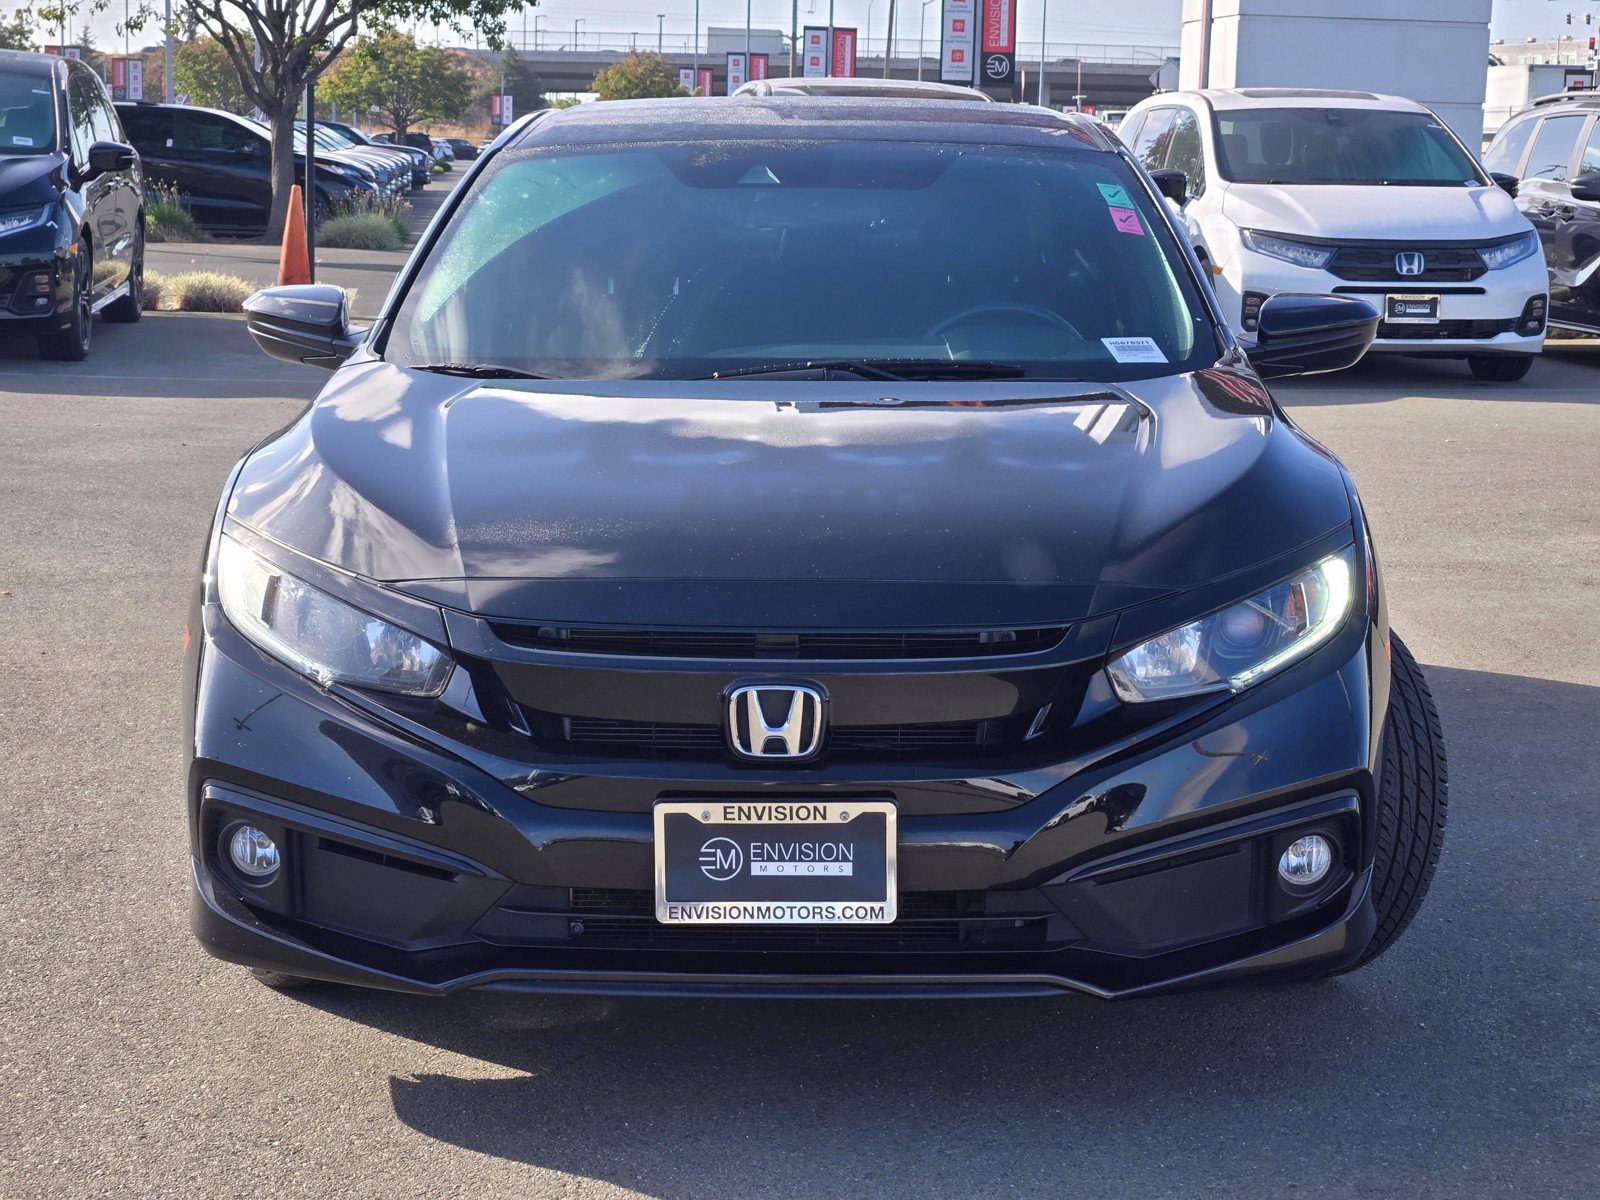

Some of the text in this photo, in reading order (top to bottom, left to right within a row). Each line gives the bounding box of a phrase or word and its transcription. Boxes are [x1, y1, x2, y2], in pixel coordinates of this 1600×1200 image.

[723, 805, 827, 821] ENVISION
[750, 842, 854, 861] ENVISION
[759, 864, 844, 873] MOTORS
[668, 905, 885, 920] ENVISIONMOTORS.COM
